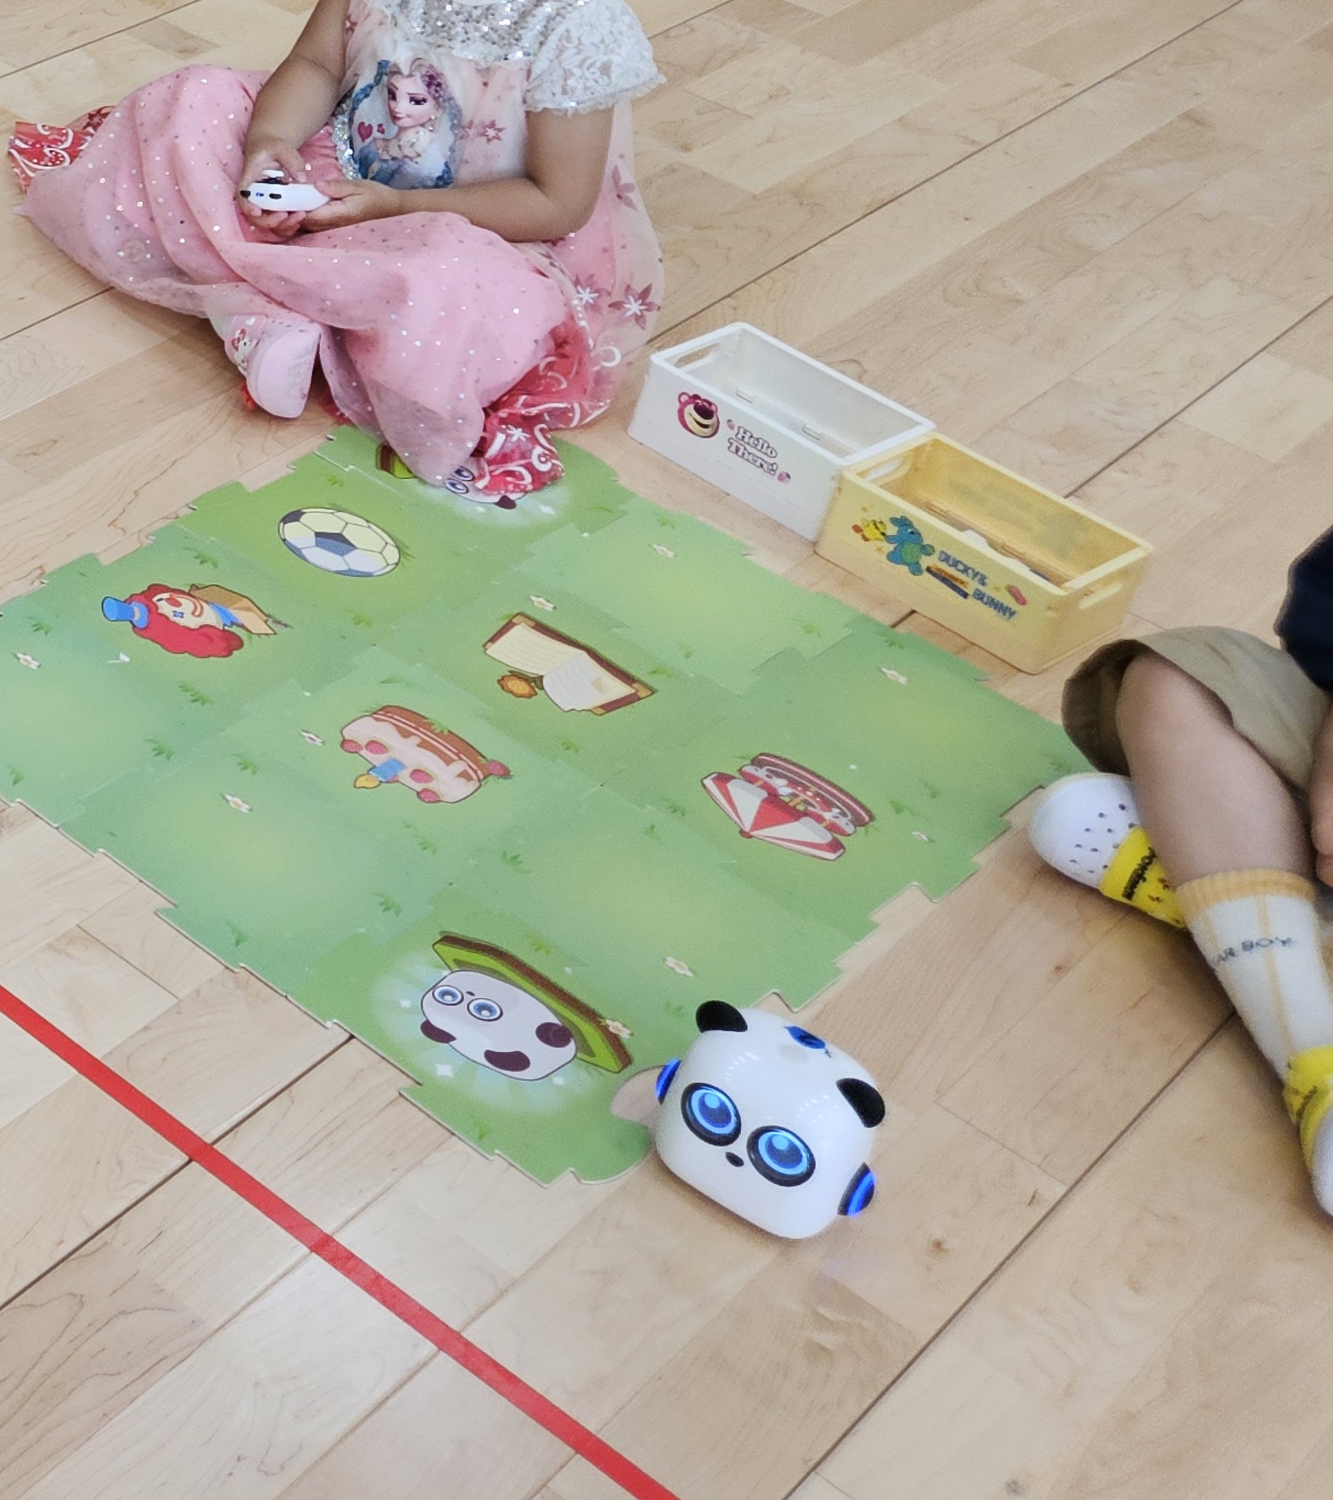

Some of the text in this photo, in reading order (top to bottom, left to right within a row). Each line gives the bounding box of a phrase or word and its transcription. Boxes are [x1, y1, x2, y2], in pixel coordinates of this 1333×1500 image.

[727, 436, 779, 476] There!
[735, 425, 778, 458] Hello
[972, 587, 1018, 620] BUNNY
